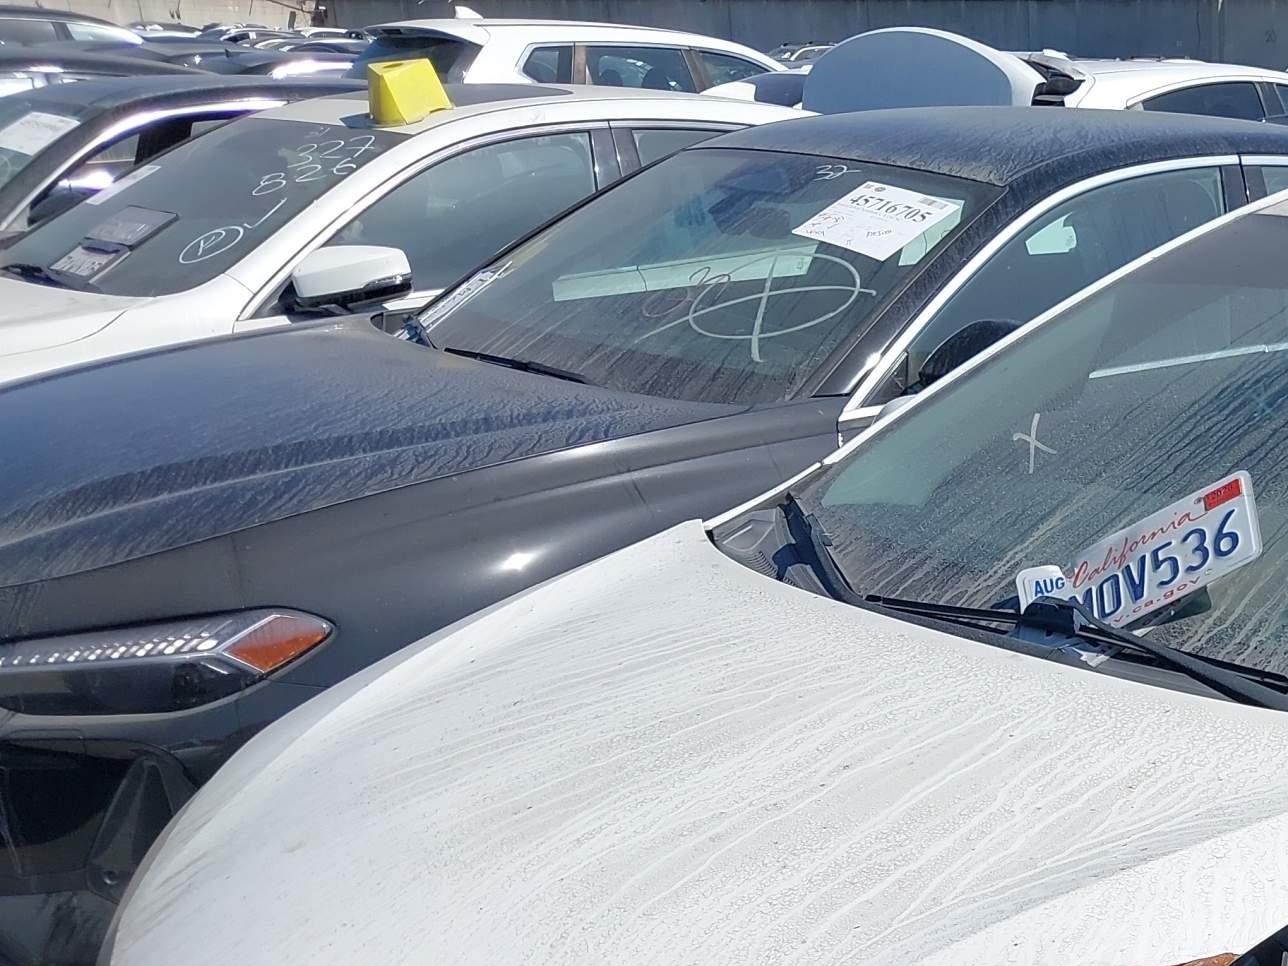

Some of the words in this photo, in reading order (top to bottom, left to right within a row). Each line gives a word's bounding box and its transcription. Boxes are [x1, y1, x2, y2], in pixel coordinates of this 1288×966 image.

[850, 194, 933, 224] 45716705
[1071, 509, 1209, 589] California
[1033, 575, 1067, 598] AUG
